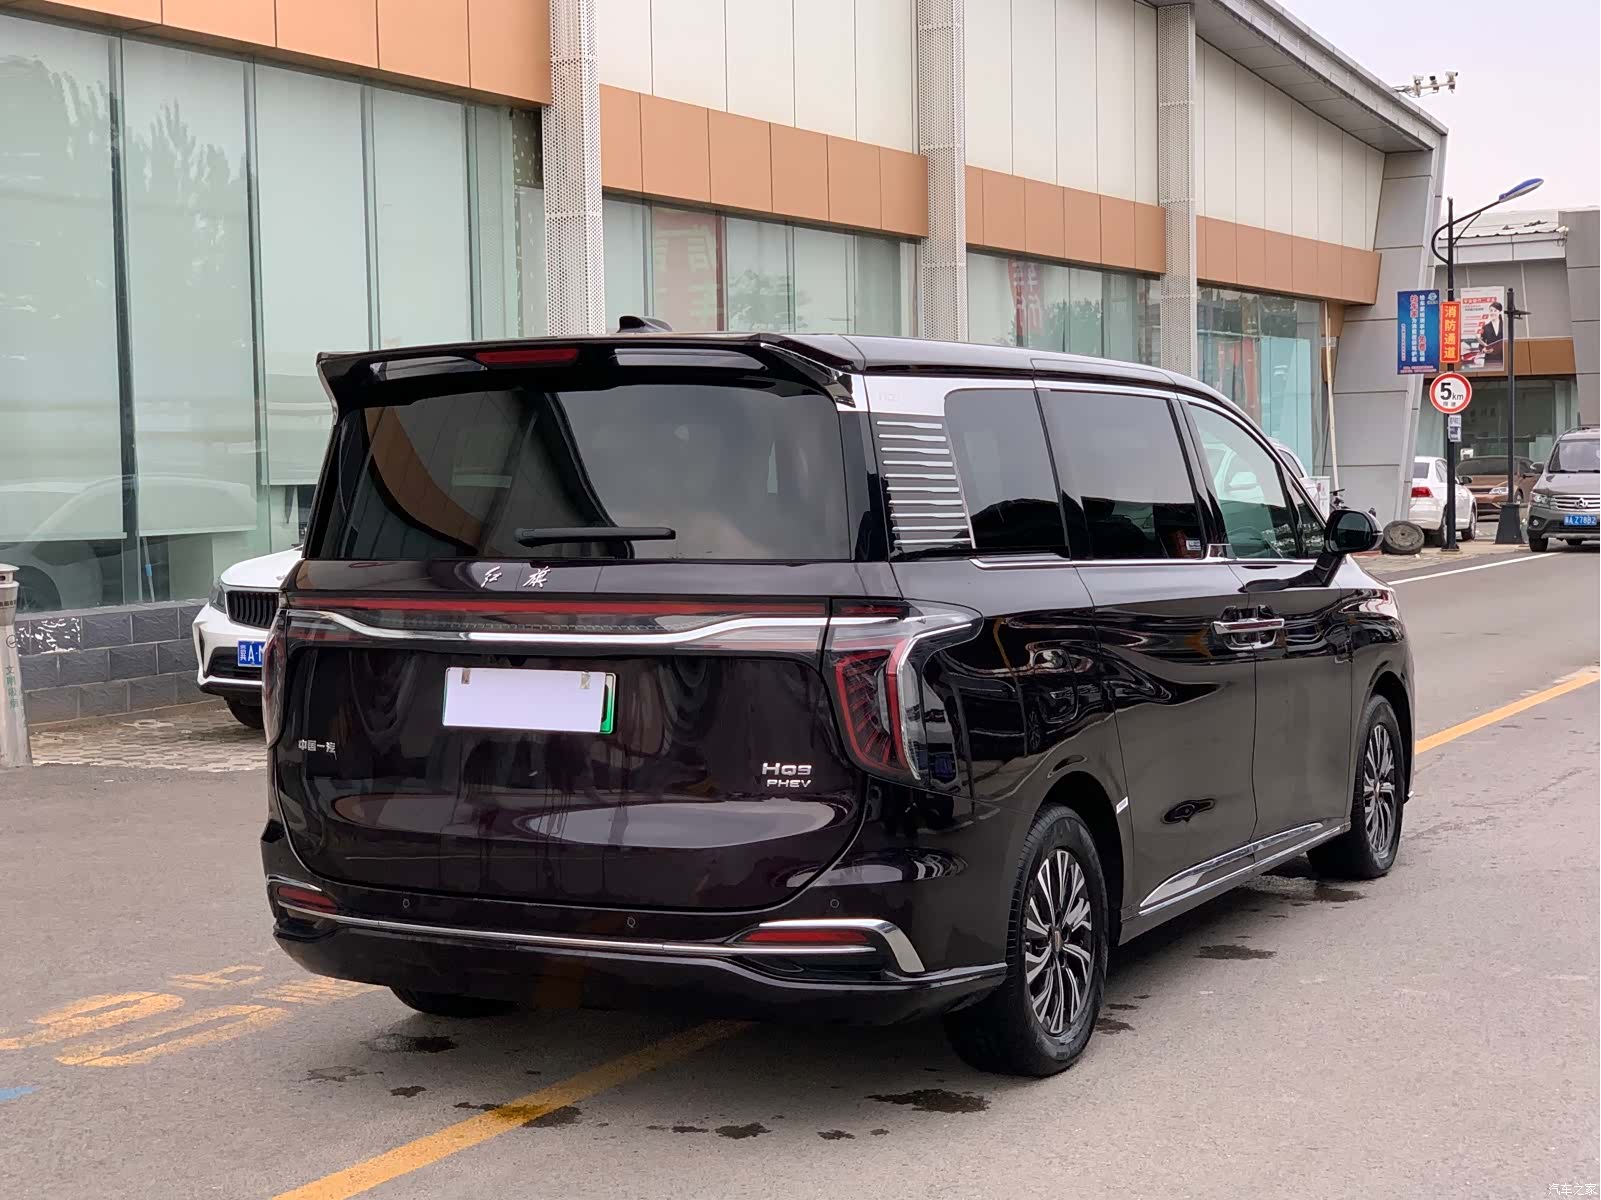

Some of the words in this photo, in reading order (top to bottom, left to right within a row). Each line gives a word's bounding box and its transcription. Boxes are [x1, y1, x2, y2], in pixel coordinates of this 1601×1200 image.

[1443, 305, 1457, 359] 消防通道
[481, 566, 551, 588] 红旗
[298, 739, 337, 760] 中国一汽
[761, 762, 812, 776] HQ9
[766, 779, 811, 788] PHEV
